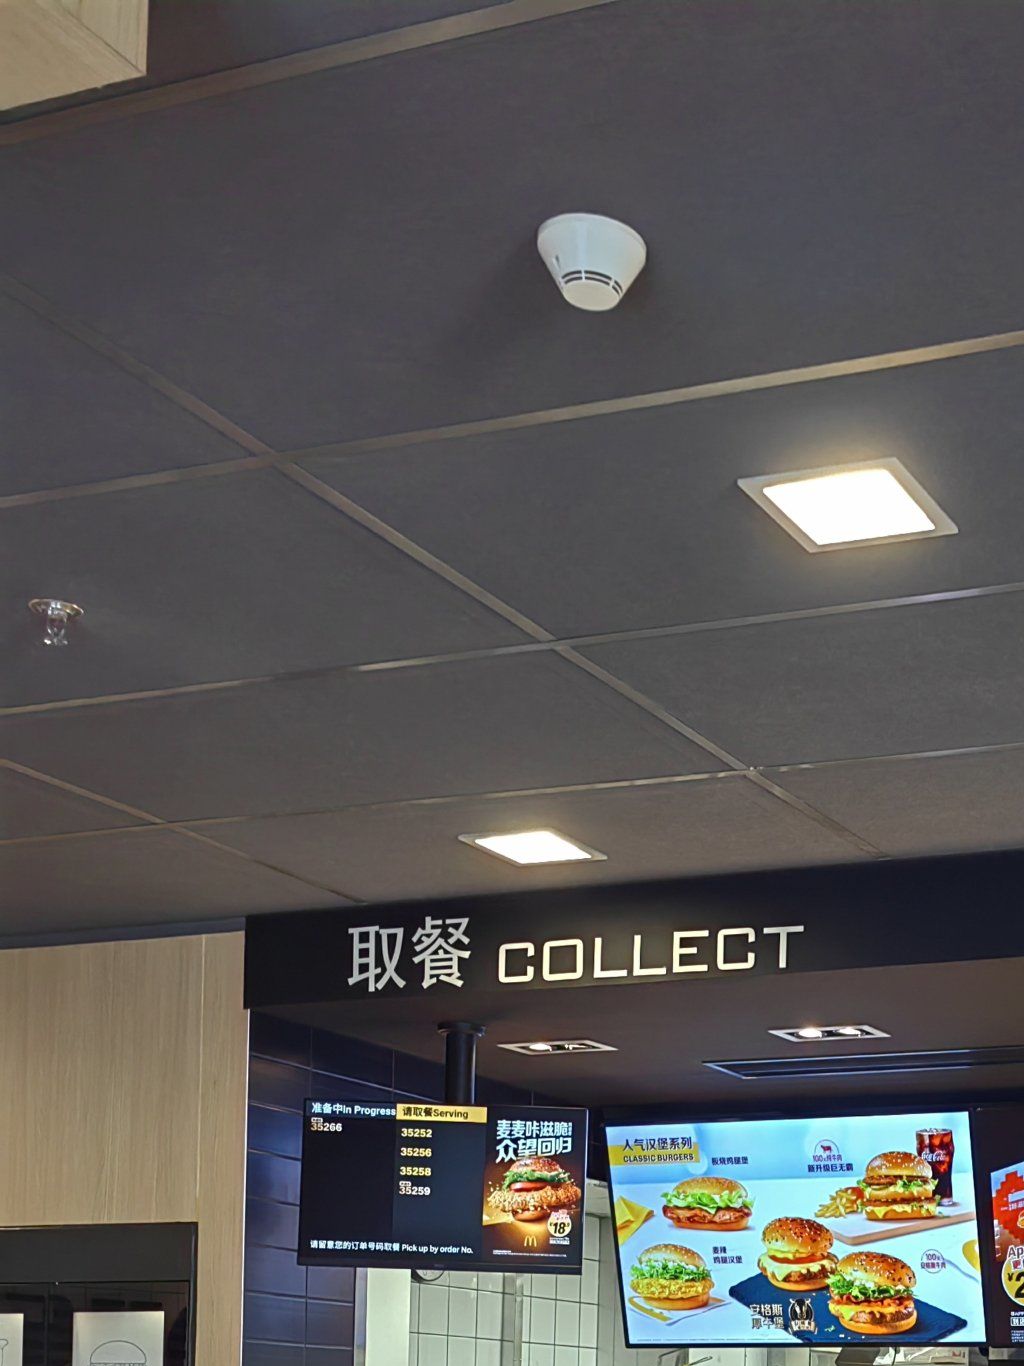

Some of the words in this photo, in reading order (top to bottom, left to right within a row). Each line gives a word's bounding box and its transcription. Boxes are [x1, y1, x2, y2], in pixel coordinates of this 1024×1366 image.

[347, 916, 472, 993] 取餐
[497, 925, 805, 984] COLLECT
[354, 1105, 396, 1116] Progress
[310, 1122, 343, 1132] 35266
[401, 1128, 433, 1138] 35252
[622, 1137, 692, 1151] 人气汉堡系列
[400, 1147, 432, 1157] 35256
[496, 1137, 572, 1163] 众望回归
[623, 1154, 656, 1163] CLASSIC
[657, 1153, 694, 1162] BURGERS
[399, 1166, 432, 1176] 35258
[807, 1163, 854, 1173] 新升级巨无霸
[399, 1186, 431, 1196] 35259
[401, 1244, 417, 1252] Pick
[429, 1245, 438, 1254] by
[439, 1245, 459, 1253] order
[460, 1246, 473, 1254] No.
[749, 1304, 783, 1316] 安格斯
